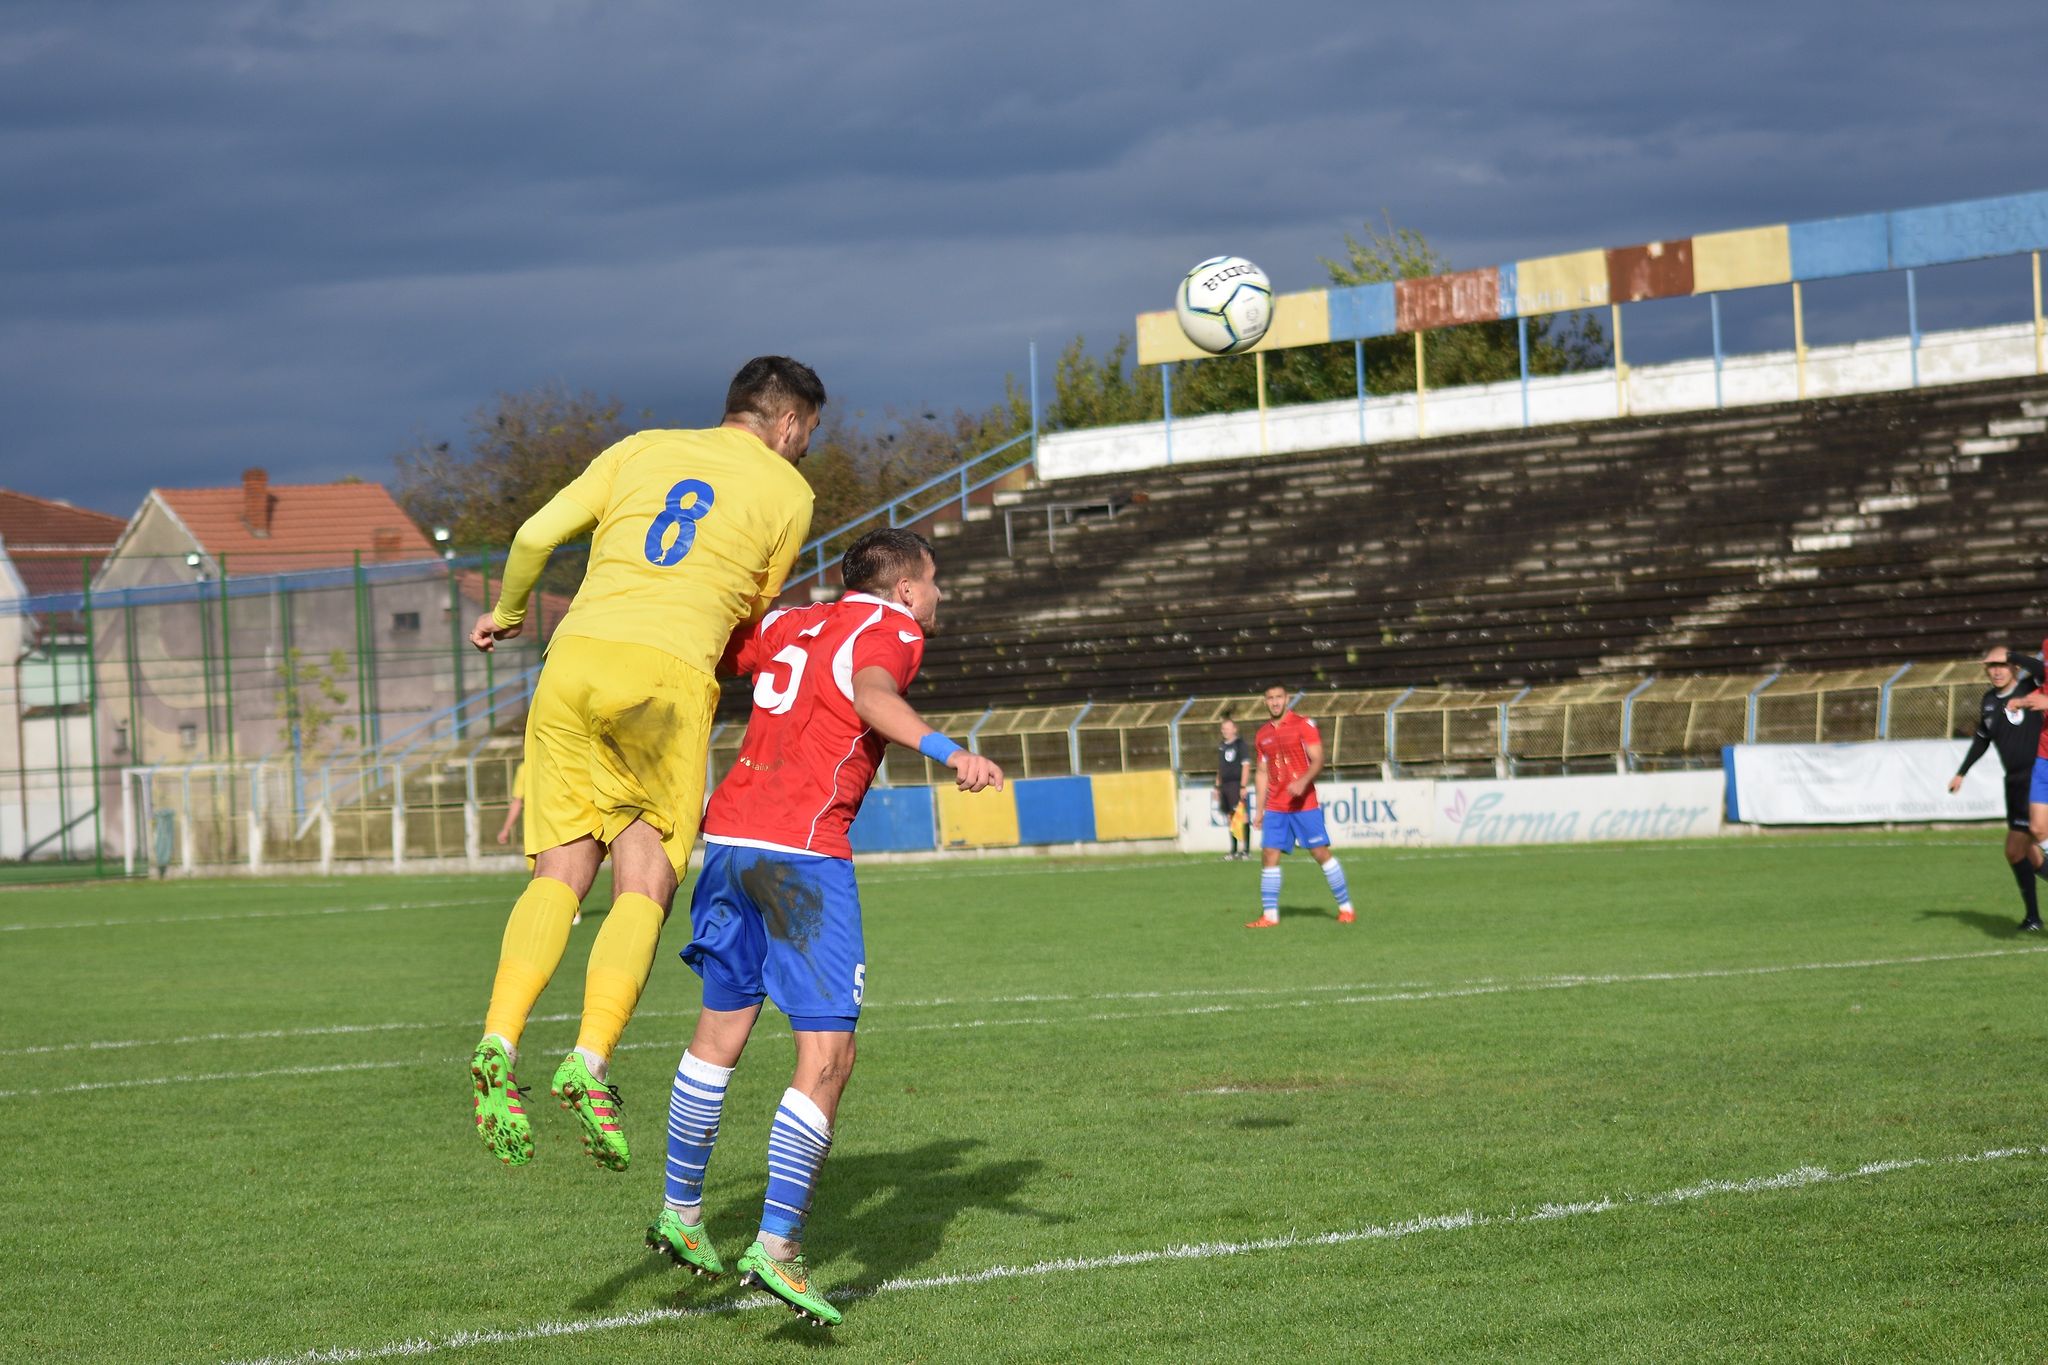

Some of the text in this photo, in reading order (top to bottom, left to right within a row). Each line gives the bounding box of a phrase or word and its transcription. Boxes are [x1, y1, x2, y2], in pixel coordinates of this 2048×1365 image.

[644, 478, 715, 567] 8
[1589, 802, 1709, 841] center
[853, 963, 866, 1006] 5
